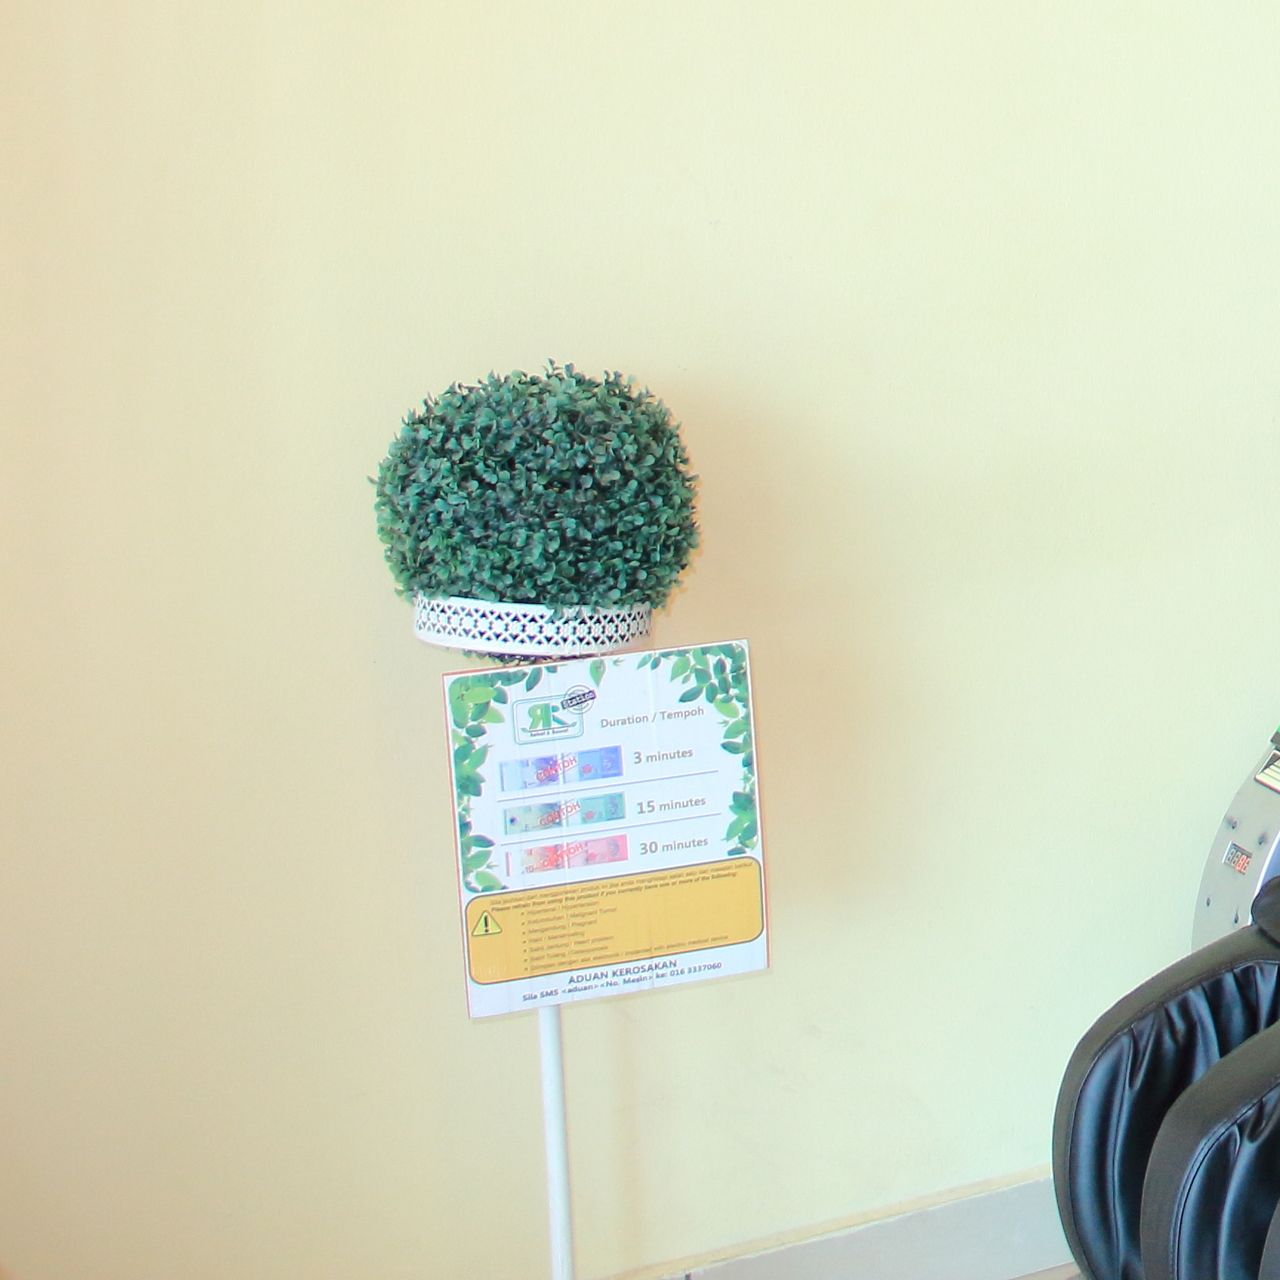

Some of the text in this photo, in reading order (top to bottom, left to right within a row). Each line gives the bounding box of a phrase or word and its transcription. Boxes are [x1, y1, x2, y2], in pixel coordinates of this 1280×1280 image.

[600, 714, 649, 728] Duration
[659, 706, 705, 721] Tempoh
[634, 748, 694, 764] 3 minutes
[536, 756, 577, 780] CONTOH
[637, 796, 706, 814] 15 minutes
[640, 837, 709, 856] 30 minutes
[568, 970, 609, 985] ADUAN
[612, 959, 678, 978] KEROSAKAN
[522, 992, 538, 1002] Sila
[540, 988, 559, 999] SMS
[670, 968, 686, 978] 016
